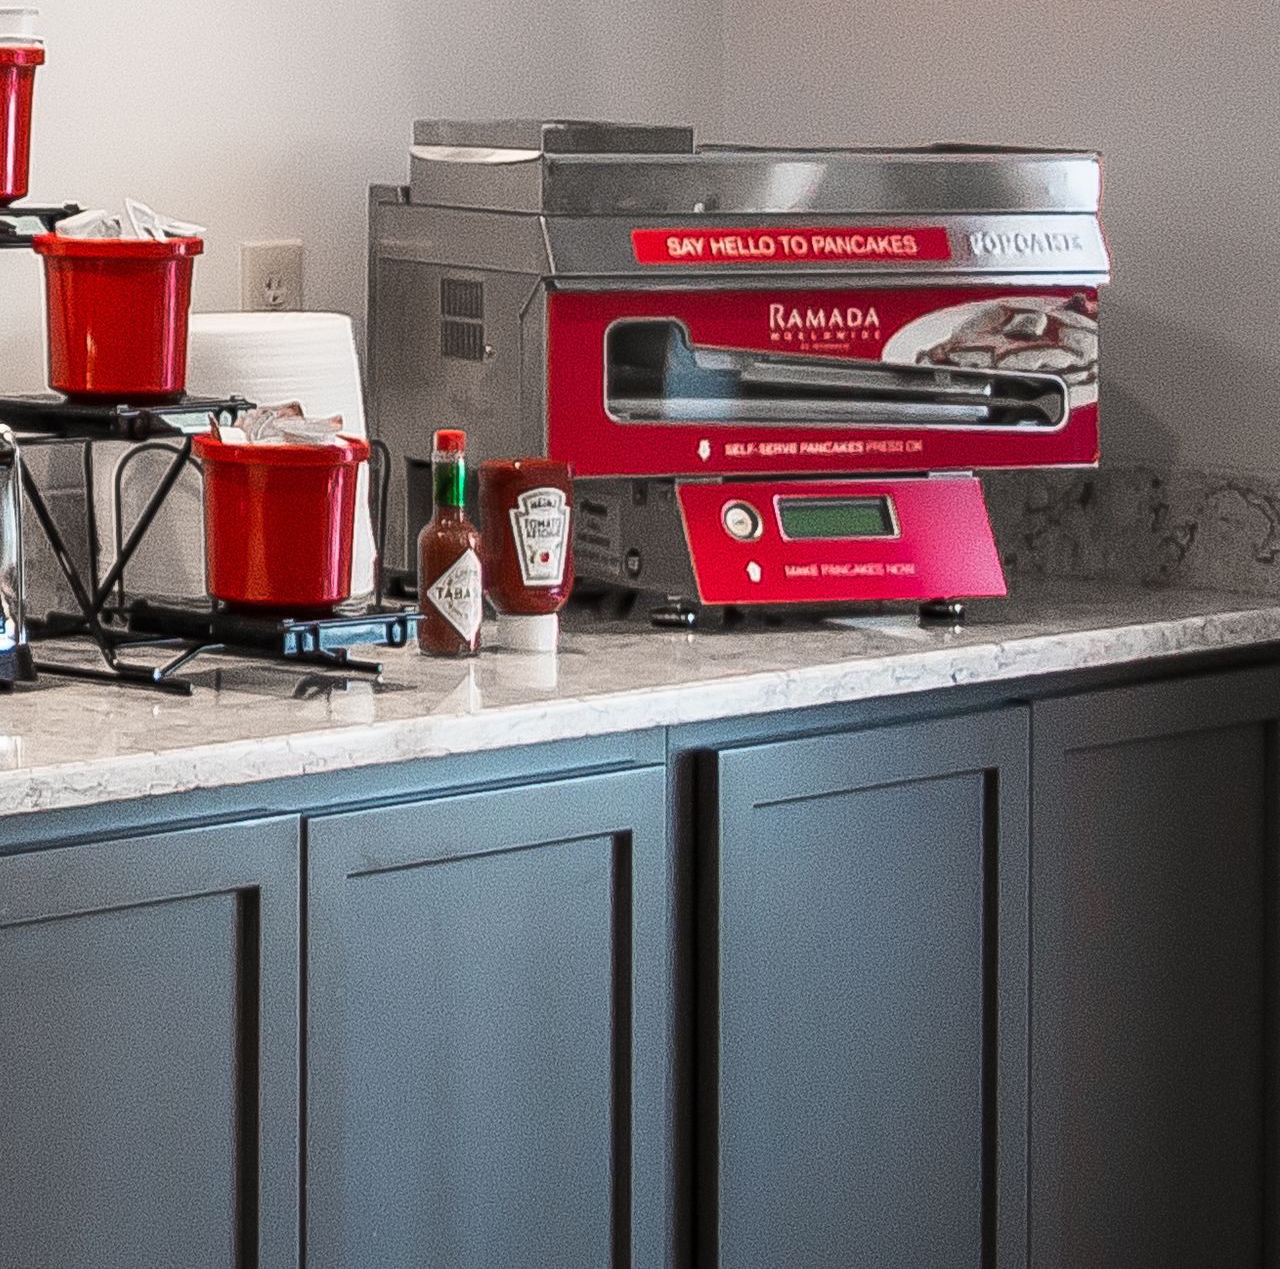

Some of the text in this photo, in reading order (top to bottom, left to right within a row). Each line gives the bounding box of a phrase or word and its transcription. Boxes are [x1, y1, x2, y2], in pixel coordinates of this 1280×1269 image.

[666, 234, 918, 257] SAY HELLO TO PANCAKES
[769, 303, 880, 329] RAMADA
[725, 441, 798, 456] SELF-SERVE
[799, 440, 864, 455] PANCAKES
